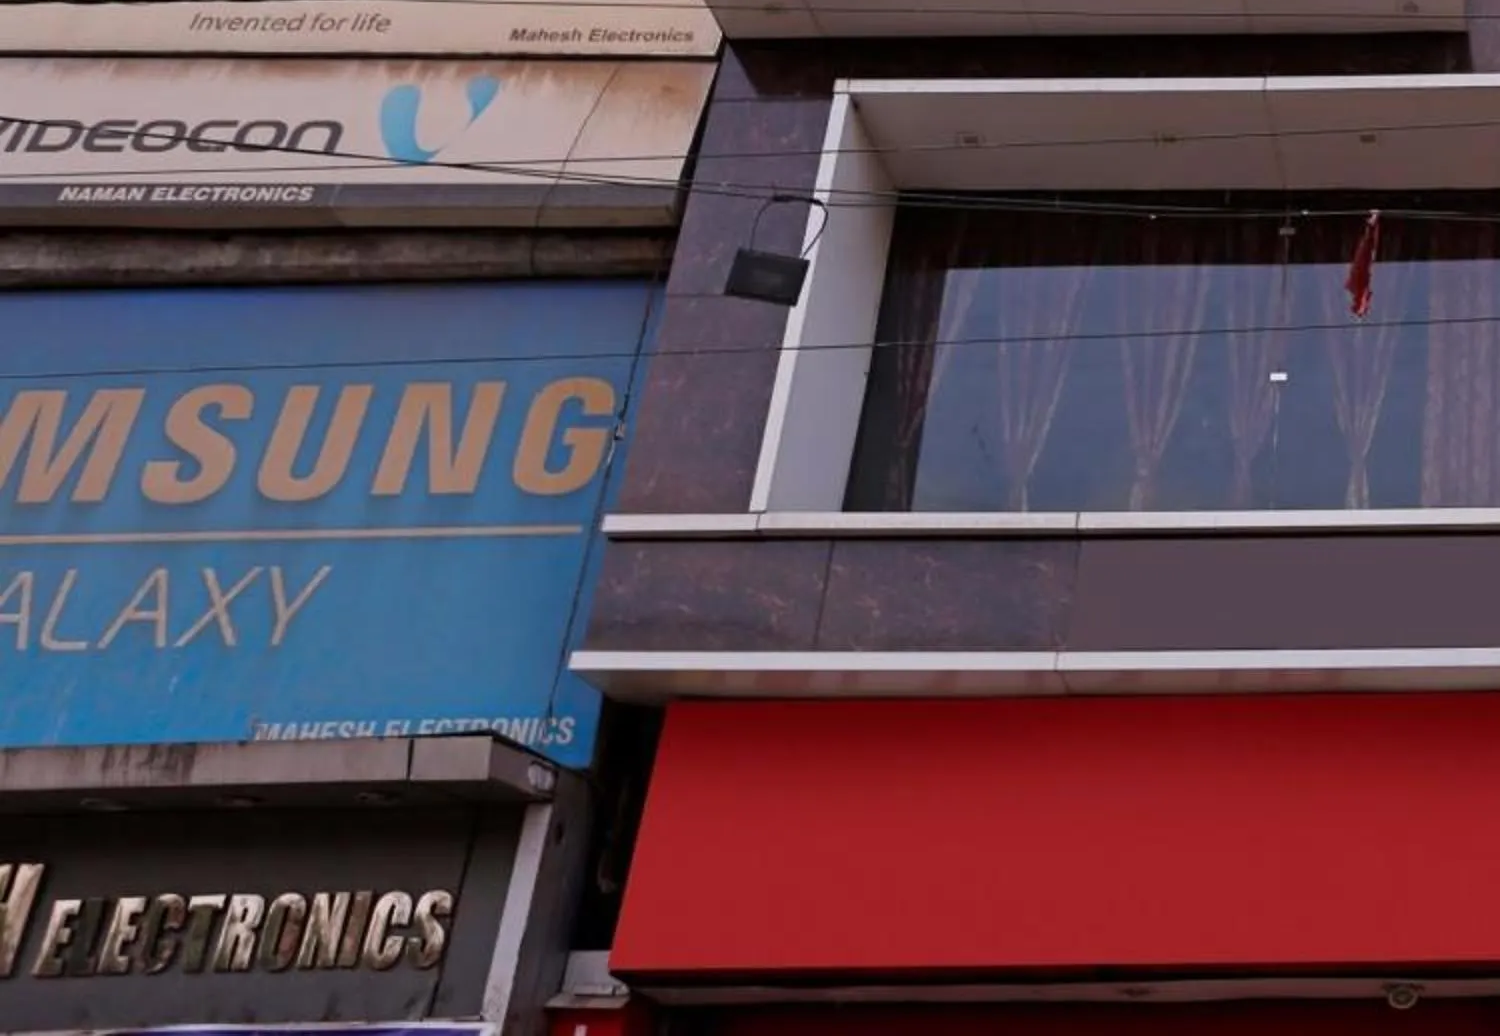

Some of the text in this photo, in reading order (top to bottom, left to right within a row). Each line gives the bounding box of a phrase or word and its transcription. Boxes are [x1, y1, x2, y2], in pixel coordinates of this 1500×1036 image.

[190, 12, 392, 33] Invented for life
[509, 28, 694, 43] Mahesh Electronics
[0, 118, 345, 154] IDEOCON
[58, 186, 314, 201] NAMAN ELECTRONICS
